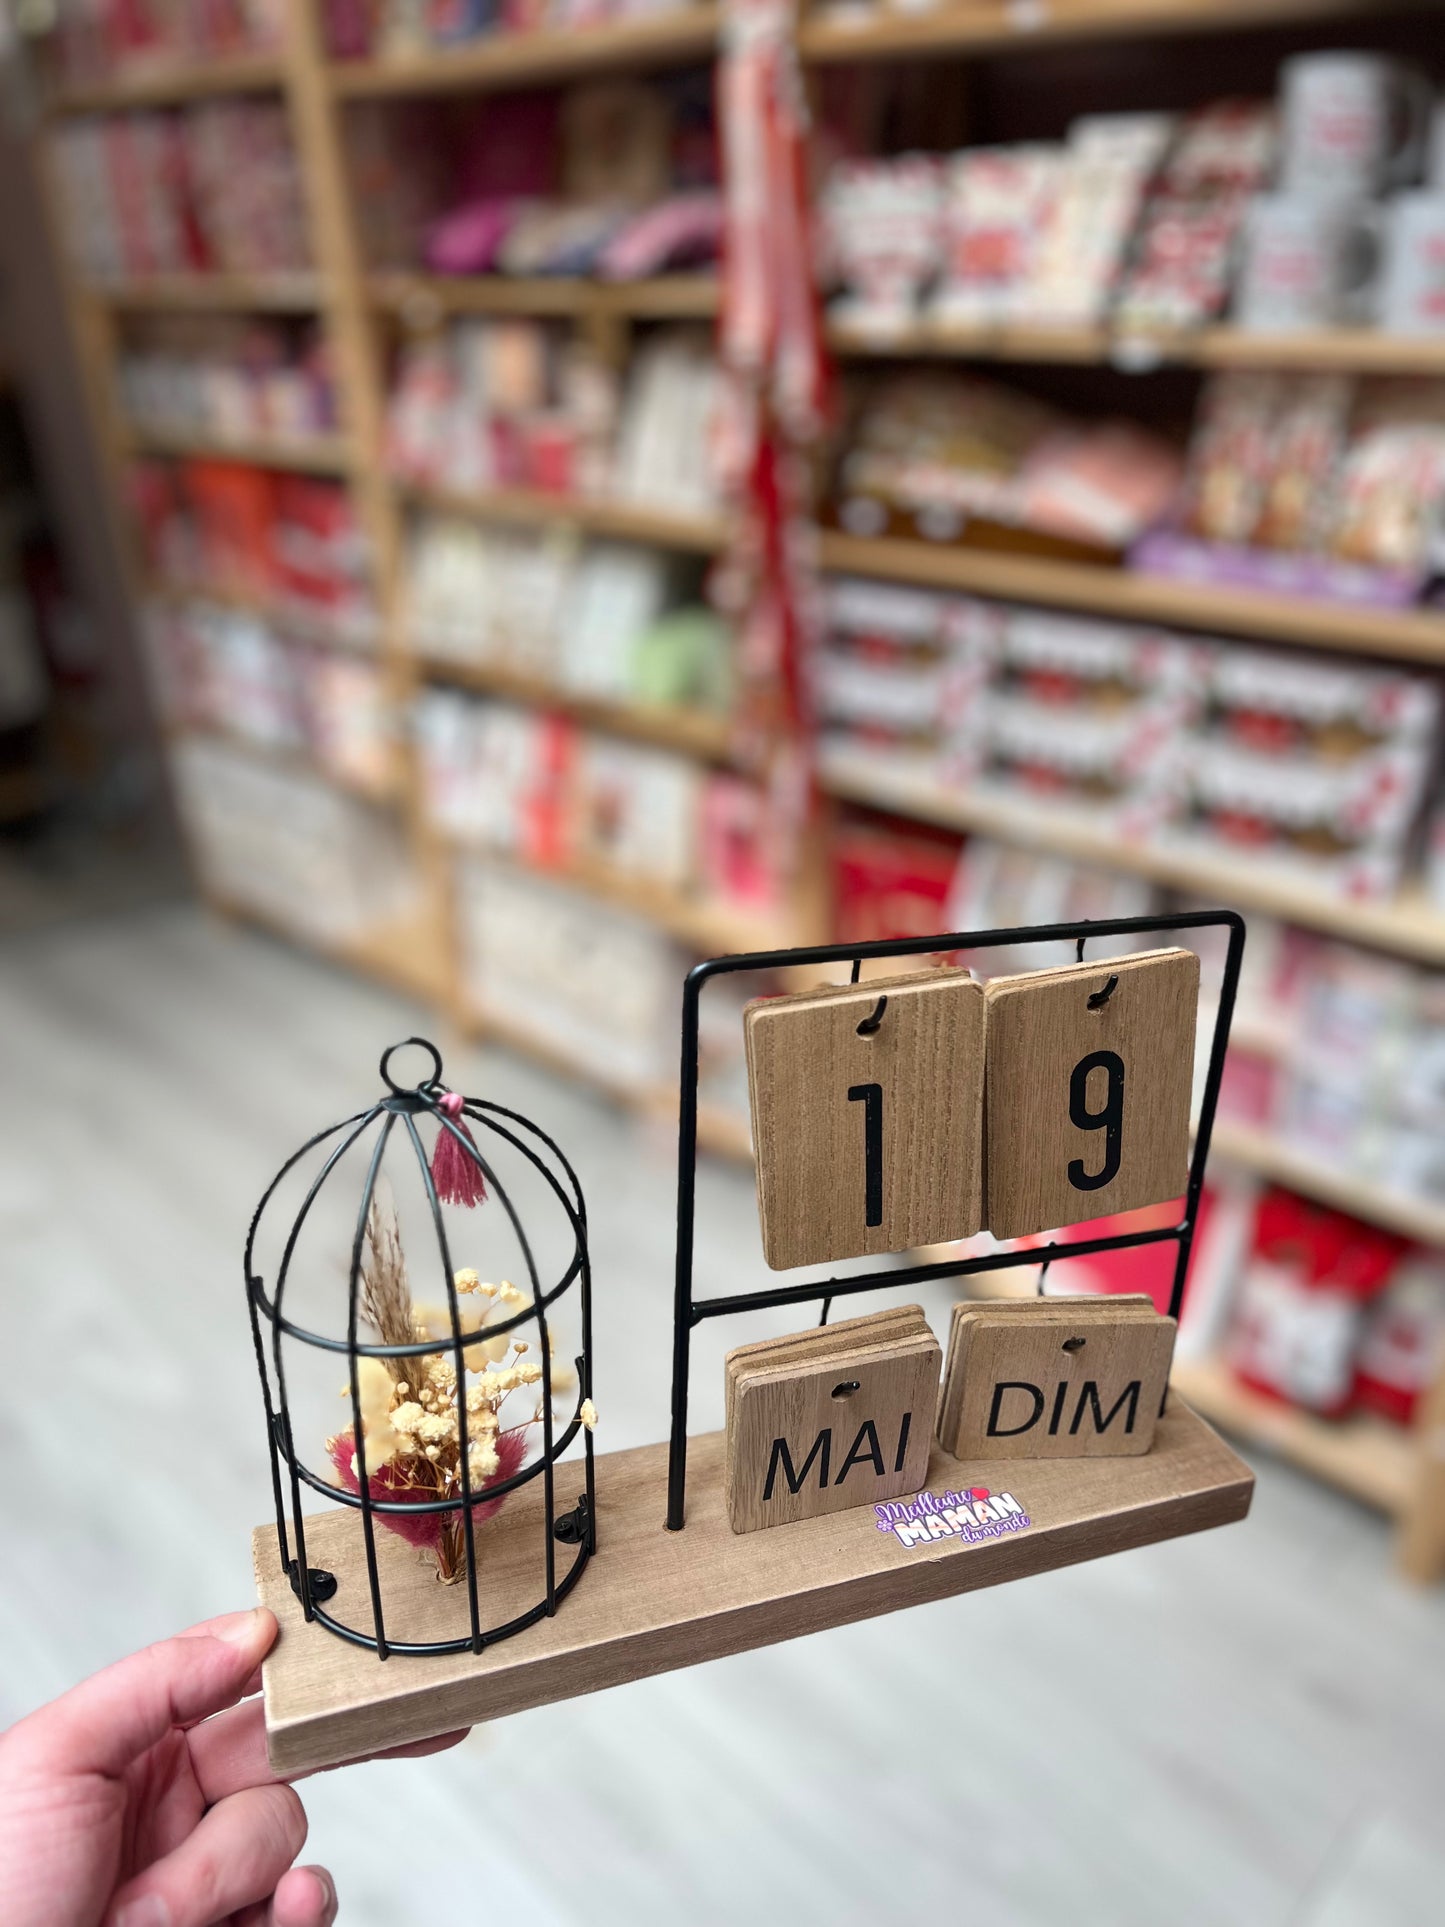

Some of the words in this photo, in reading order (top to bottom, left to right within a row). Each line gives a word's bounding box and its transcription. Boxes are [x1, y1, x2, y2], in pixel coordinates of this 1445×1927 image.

[848, 1083, 882, 1227] 1
[1068, 1051, 1124, 1191] 9
[986, 1380, 1142, 1438] DIM
[762, 1412, 912, 1501] MAI
[875, 1490, 971, 1522] Meilleure
[894, 1493, 1024, 1548] MAMAN
[961, 1526, 983, 1543] du
[984, 1512, 1030, 1536] monde
